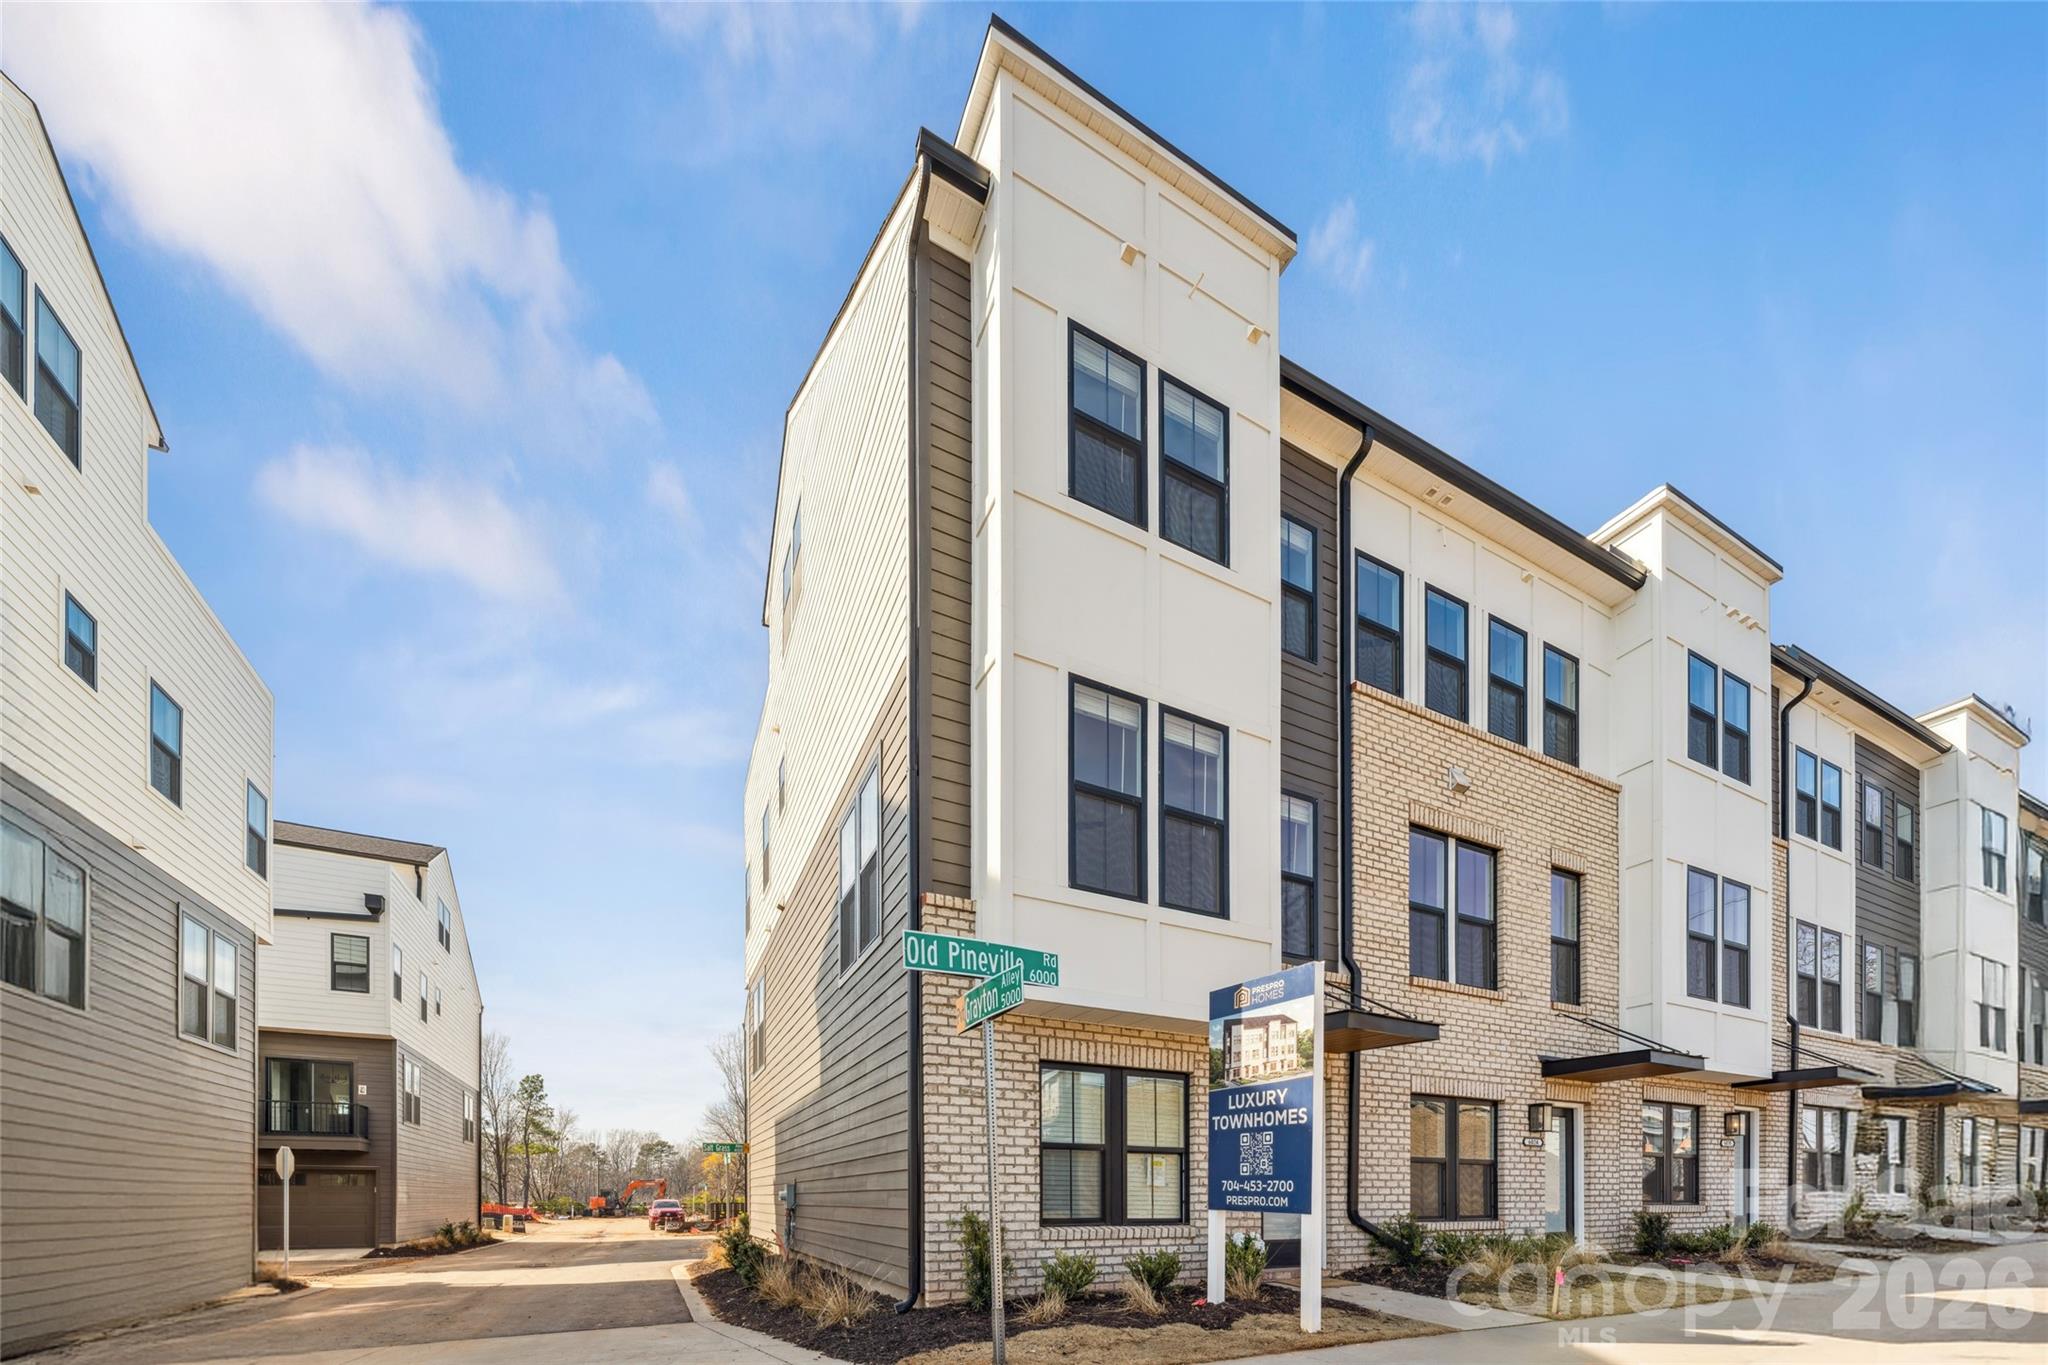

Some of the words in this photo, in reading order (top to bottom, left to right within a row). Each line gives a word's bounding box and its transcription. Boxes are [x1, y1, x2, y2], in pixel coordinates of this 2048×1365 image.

[906, 935, 938, 967] Old
[1043, 953, 1057, 968] Rd
[1001, 970, 1020, 988] Alley
[1029, 969, 1057, 986] 6000
[1251, 979, 1285, 995] PRESPRO
[965, 986, 999, 1023] Grayton
[1001, 987, 1021, 1008] 5000
[1251, 988, 1284, 1005] HOMES
[1228, 1088, 1288, 1110] LUXURY
[1212, 1107, 1308, 1131] TOWNHOMES
[1222, 1180, 1294, 1192] 704-453-2700
[1226, 1195, 1289, 1207] PRESPRO.COM
